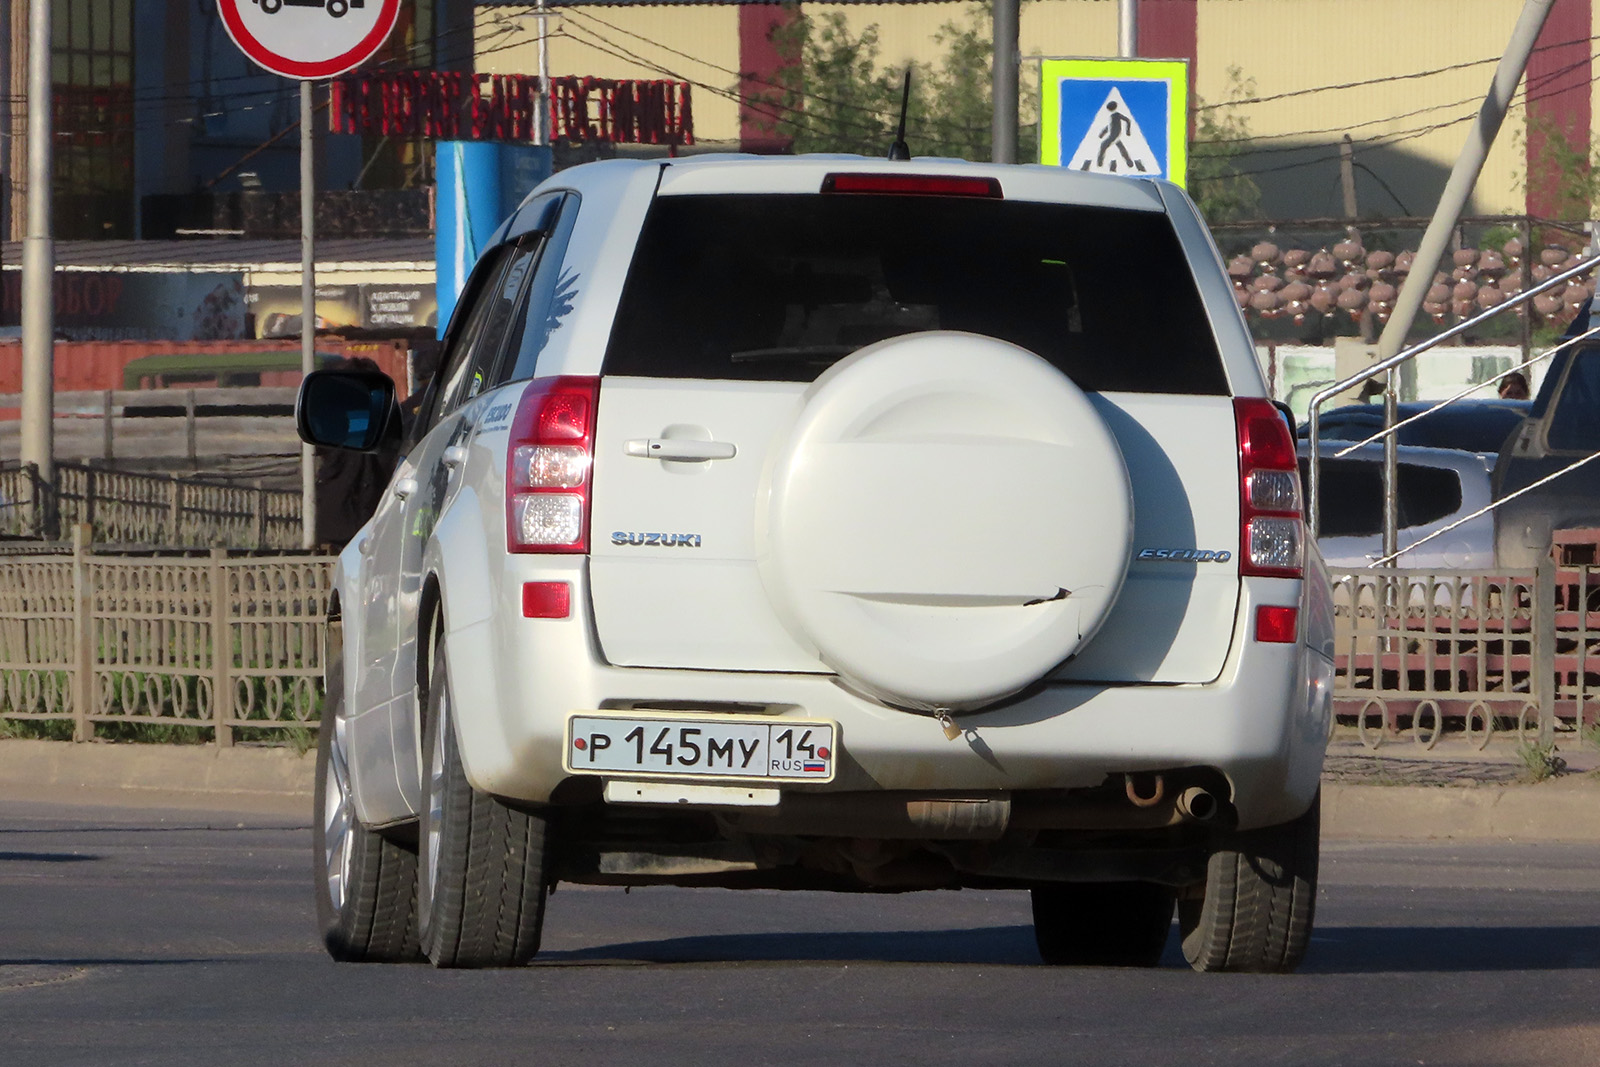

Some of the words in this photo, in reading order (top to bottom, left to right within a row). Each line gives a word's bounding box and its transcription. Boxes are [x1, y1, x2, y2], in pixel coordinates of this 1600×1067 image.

[611, 531, 701, 547] SUZUKI
[1136, 549, 1232, 563] ESCUDO
[776, 729, 815, 759] 14
[771, 760, 802, 771] RUS
